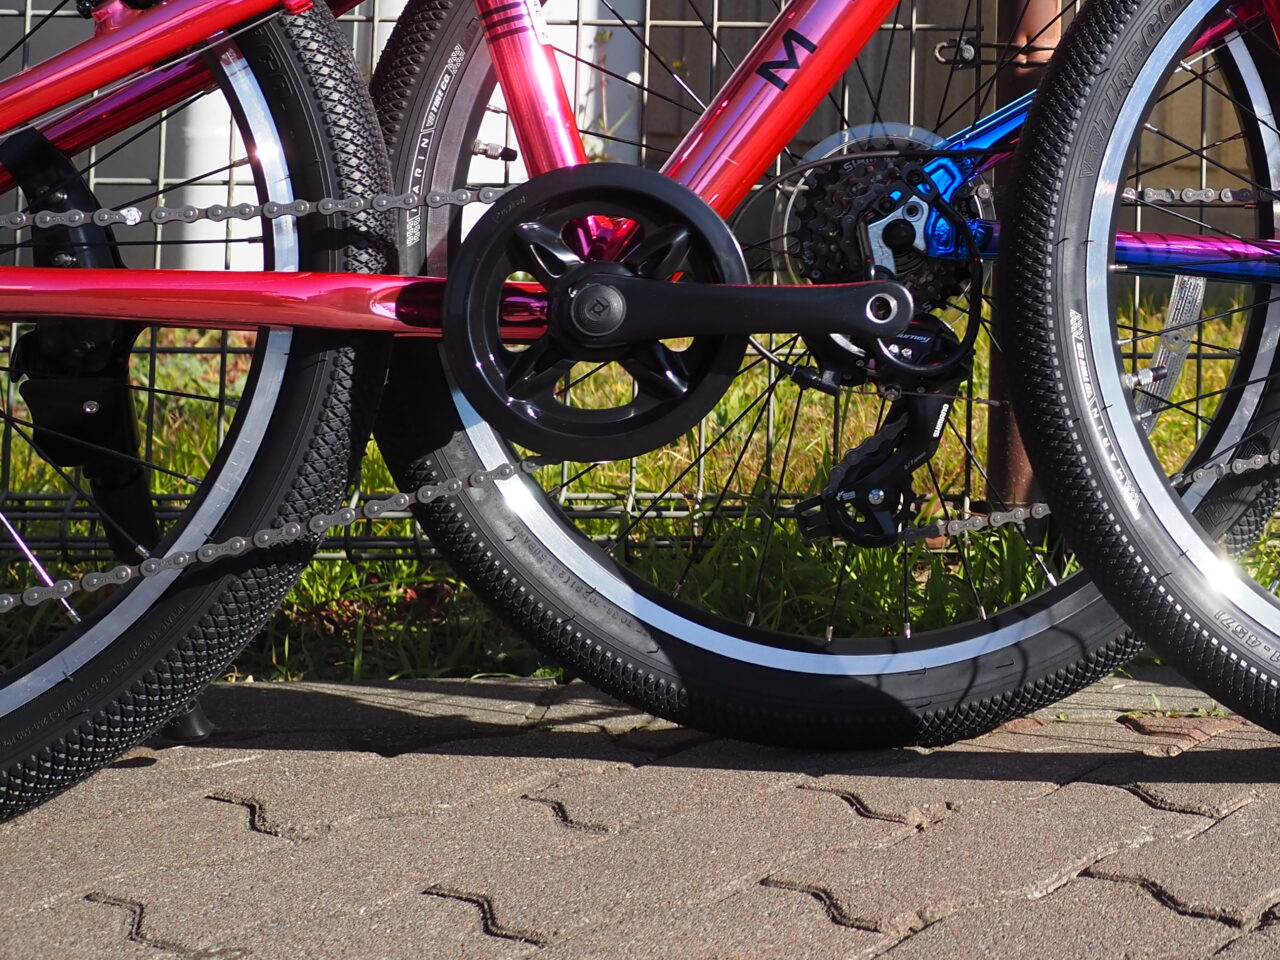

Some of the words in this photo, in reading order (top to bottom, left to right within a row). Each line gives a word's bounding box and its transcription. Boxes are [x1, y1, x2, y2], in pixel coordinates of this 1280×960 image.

[411, 138, 430, 212] ARIN
[932, 403, 950, 438] SHIMANO
[1092, 407, 1126, 480] MARIN
